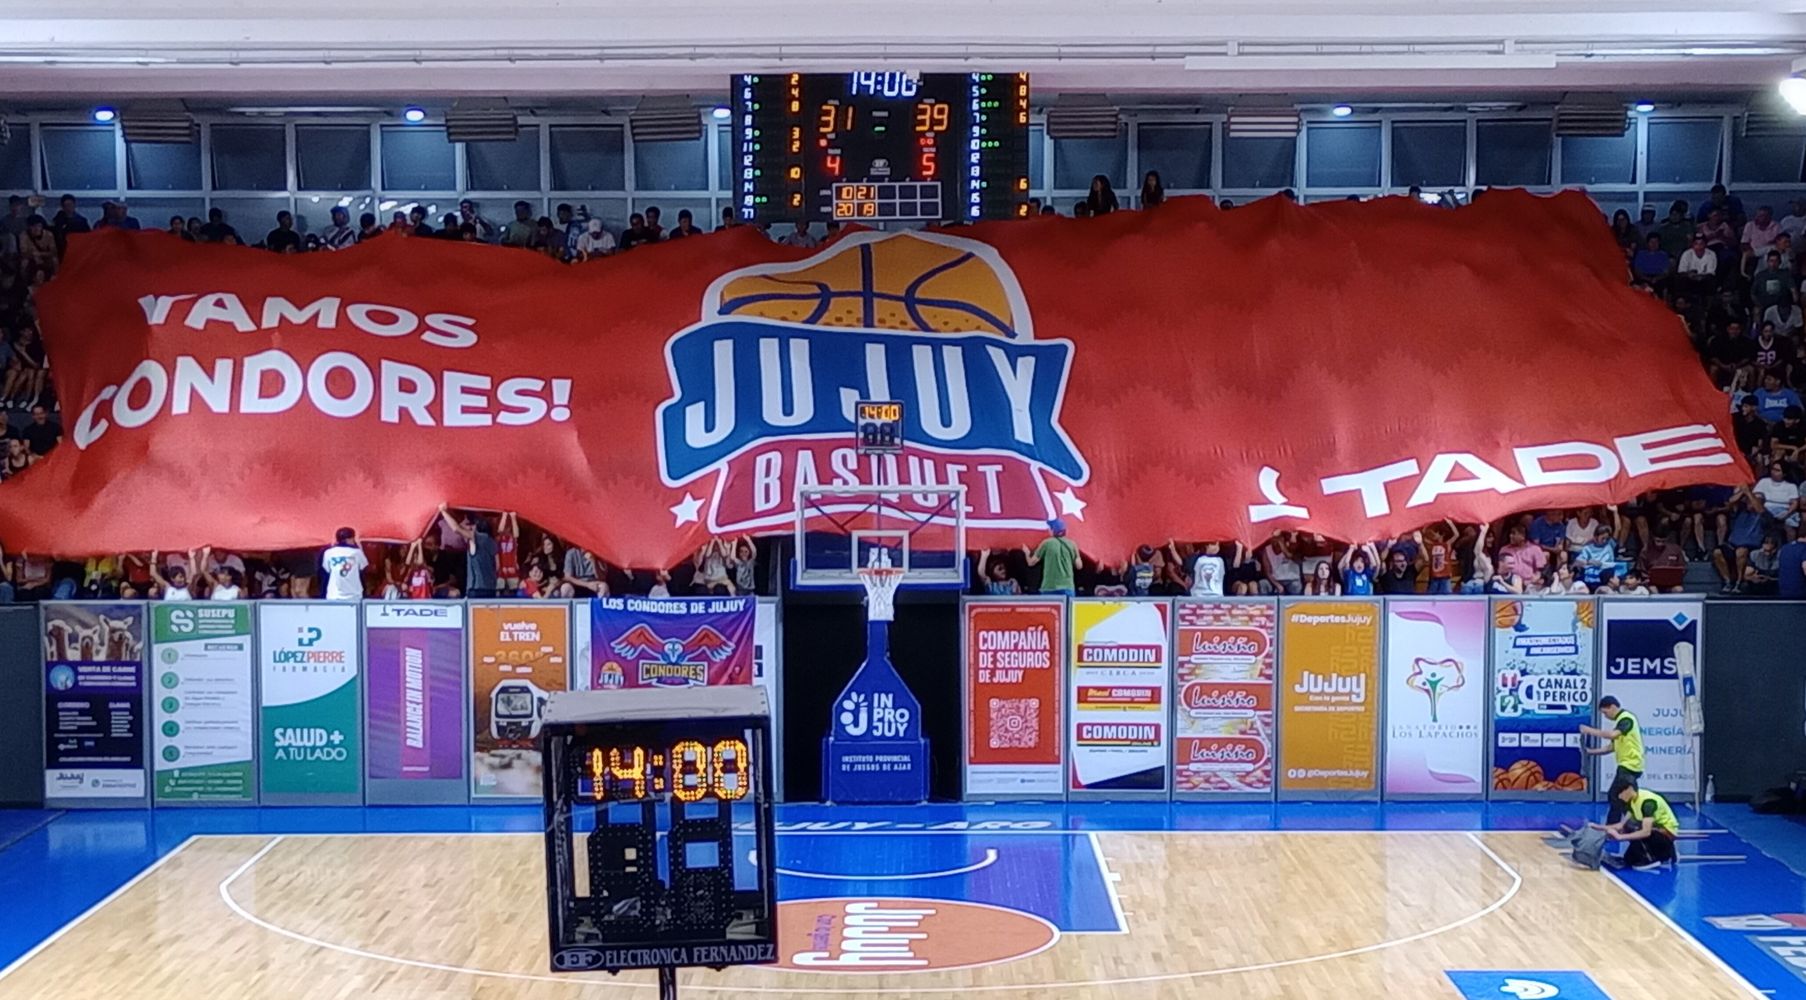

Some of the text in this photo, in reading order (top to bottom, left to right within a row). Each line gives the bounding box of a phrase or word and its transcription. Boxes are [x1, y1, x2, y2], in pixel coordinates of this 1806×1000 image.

[791, 74, 800, 85] 2
[820, 105, 853, 132] 31
[916, 104, 949, 131] 39
[792, 127, 800, 139] 3
[791, 140, 800, 152] 2
[826, 156, 840, 176] 4
[922, 153, 935, 176] 5
[1019, 178, 1028, 190] 6
[792, 194, 801, 206] 2
[857, 186, 874, 199] 21
[836, 203, 853, 216] 20
[863, 203, 874, 216] 19
[1019, 205, 1028, 216] 2
[73, 349, 573, 450] CONDORES!
[685, 337, 1036, 448] JUJUY
[1320, 423, 1735, 518] TADE
[754, 449, 1004, 513] BASQUET
[392, 608, 448, 617] TADE
[602, 597, 746, 614] LOS CONDORES DE JUJUY
[502, 620, 538, 631] vuelve
[1291, 614, 1373, 626] #DeportesJujuy
[500, 631, 540, 642] EL TREN
[978, 625, 1051, 651] COMPAÑÍA
[1192, 631, 1258, 654] Luisiño
[272, 647, 345, 664] LÓPEZ PIERRE
[978, 651, 1051, 668] DE SEGUROS
[1082, 648, 1156, 662] COMODIN
[405, 647, 424, 690] MOTION
[642, 663, 705, 681] CONDORES
[1609, 657, 1677, 675] JEMS
[978, 669, 1024, 683] DE JUJUY
[1538, 677, 1587, 690] CANAL 2
[873, 692, 893, 708] IN
[1191, 686, 1257, 708] Luisiño
[1543, 690, 1589, 702] PERICO
[872, 708, 910, 723] PRO
[405, 703, 424, 748] BALANCE
[872, 722, 909, 737] JUY
[1081, 725, 1156, 739] COMODIN
[1640, 725, 1685, 736] NERGÍA
[274, 727, 328, 747] SALUD
[275, 747, 348, 761] A TU LADO
[1190, 739, 1256, 762] Luisiño
[588, 740, 748, 801] 14:00
[605, 948, 688, 968] ELECTRONICA
[692, 943, 775, 964] FERNANDEZ
